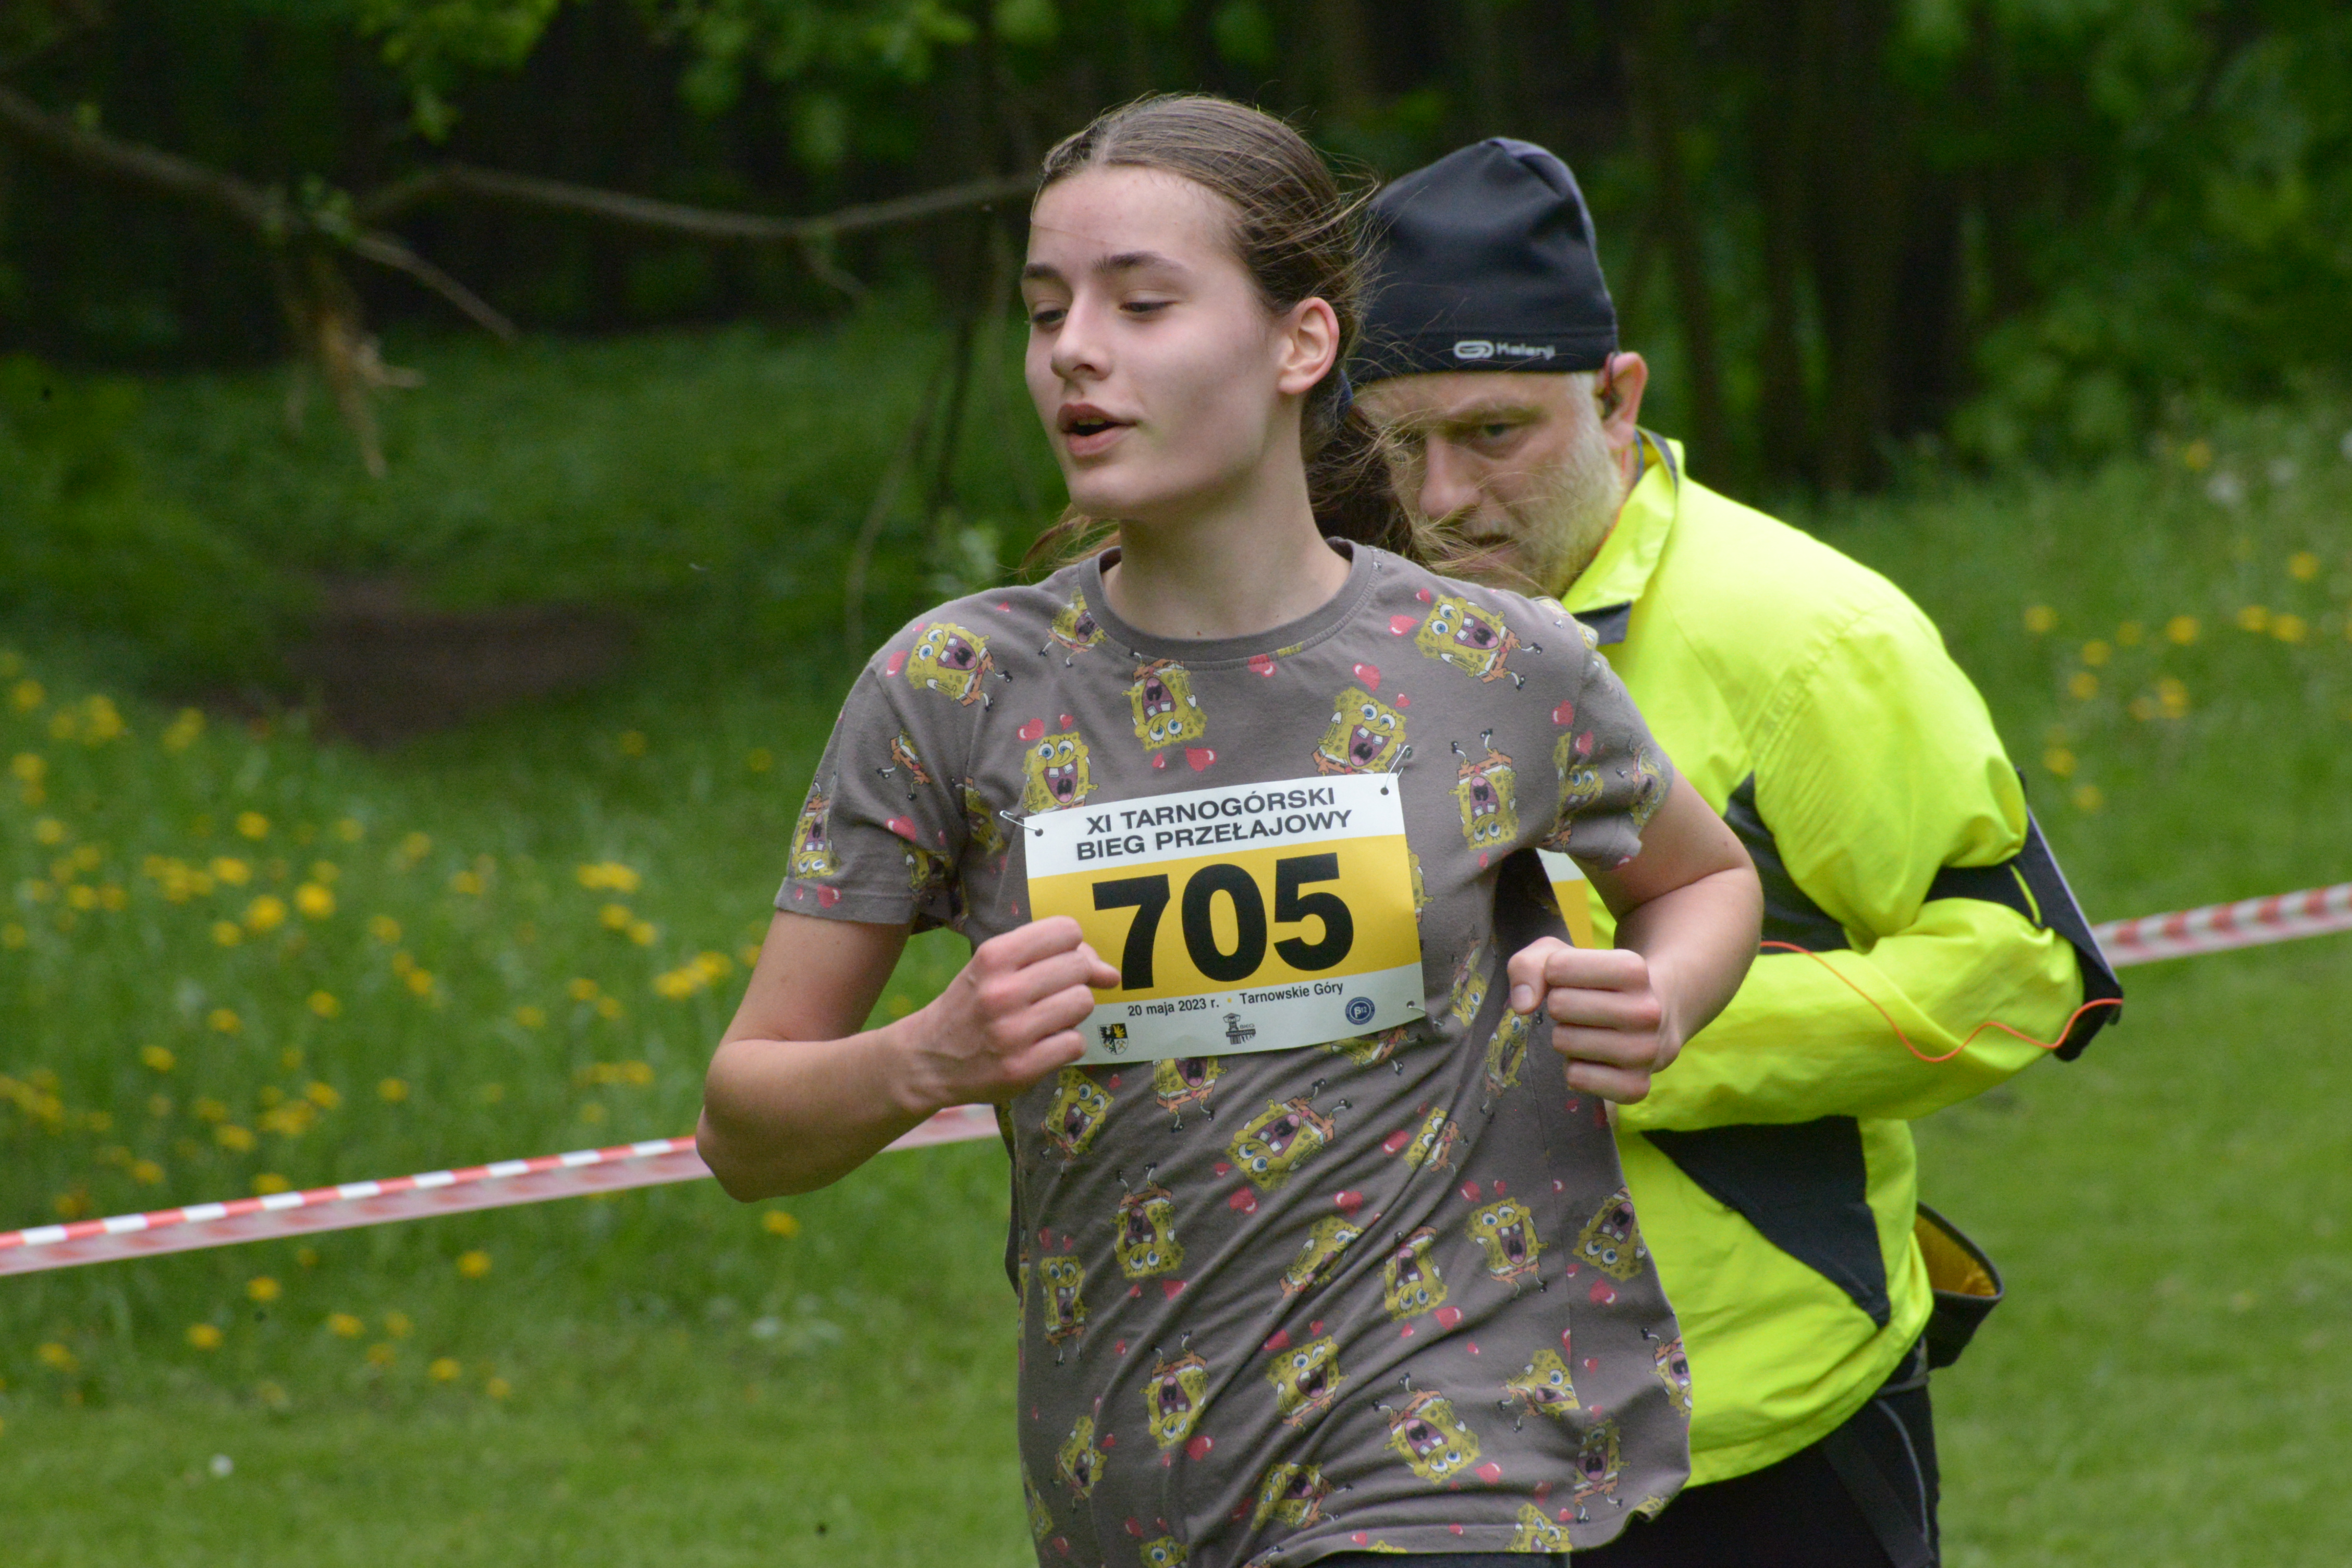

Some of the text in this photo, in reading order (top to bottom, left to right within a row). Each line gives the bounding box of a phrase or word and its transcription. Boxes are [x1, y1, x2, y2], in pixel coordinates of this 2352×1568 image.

[1076, 810, 1352, 861] BIEG PRZEŁAJOWY
[1086, 787, 1334, 835] XI TARNOGÓRSKI
[1092, 852, 1354, 990] 705
[1128, 982, 1343, 1016] 20 maja 2023 r. Tarnowskie Góry
